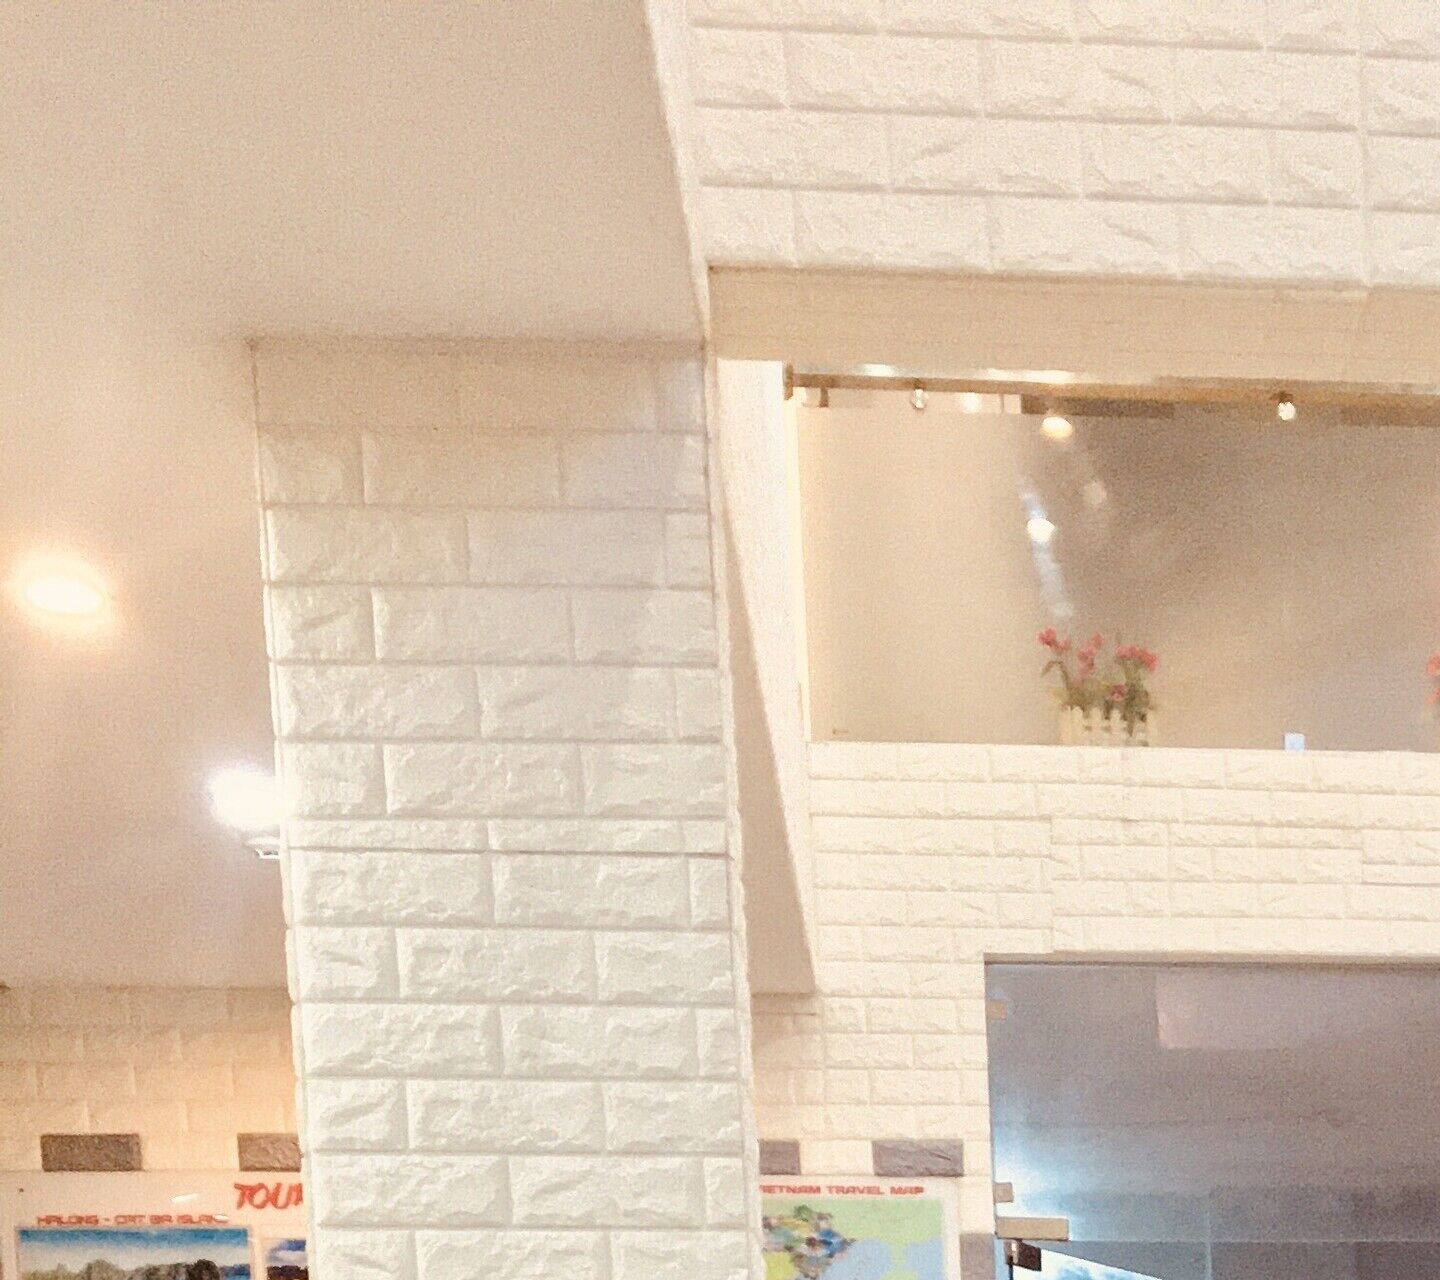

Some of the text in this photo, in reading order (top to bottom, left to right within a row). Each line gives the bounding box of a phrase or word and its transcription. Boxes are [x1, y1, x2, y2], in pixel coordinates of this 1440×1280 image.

[759, 1185, 924, 1195] IETNAM TRAVEL MAP
